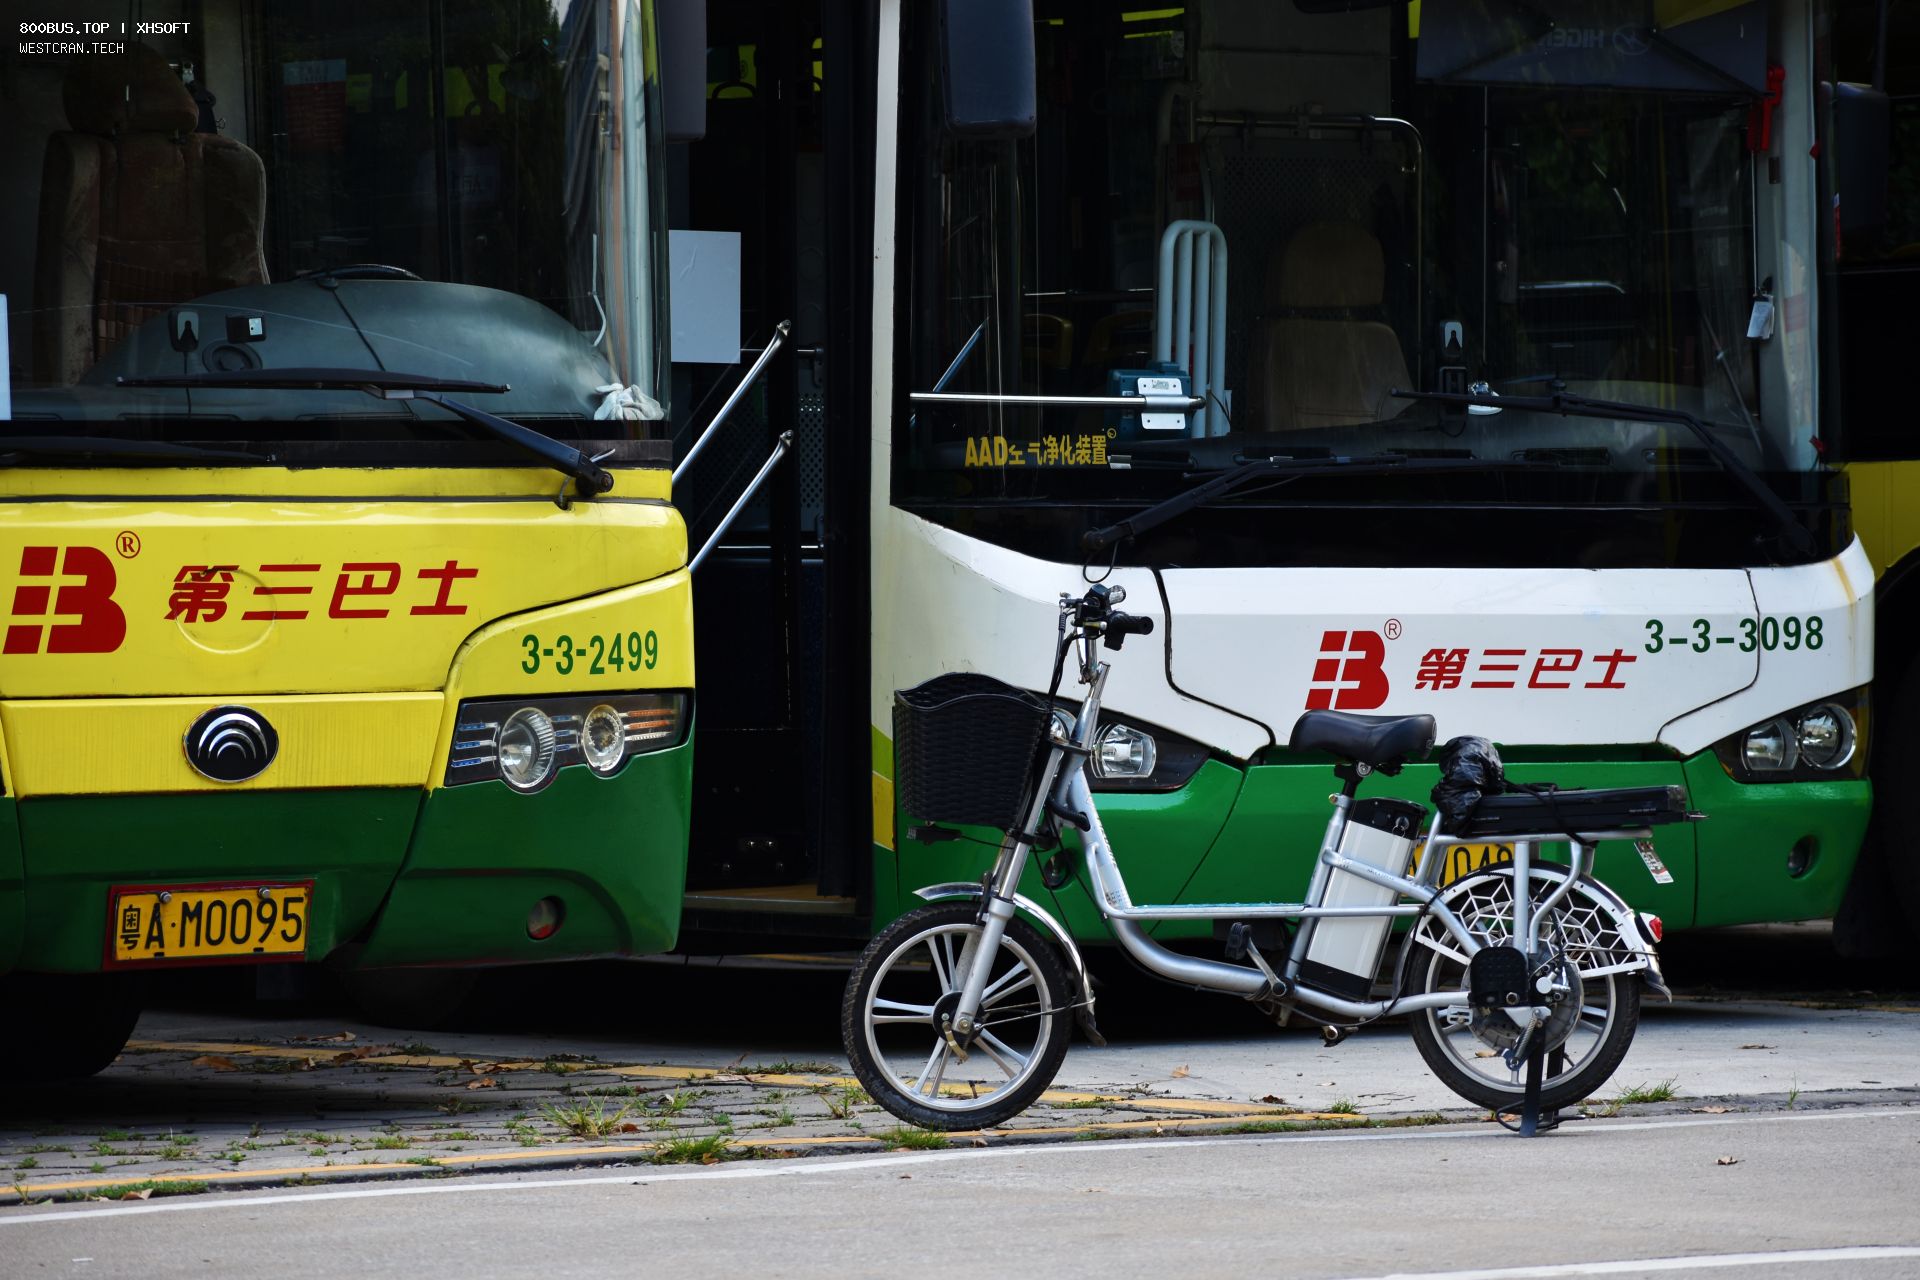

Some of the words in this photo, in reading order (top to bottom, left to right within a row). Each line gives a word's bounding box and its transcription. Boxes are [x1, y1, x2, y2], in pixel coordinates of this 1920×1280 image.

[164, 560, 479, 623] 第三巴士
[521, 630, 658, 675] 3-3-2499
[1644, 615, 1824, 654] 3-3-3098
[1415, 648, 1638, 690] 第三巴士
